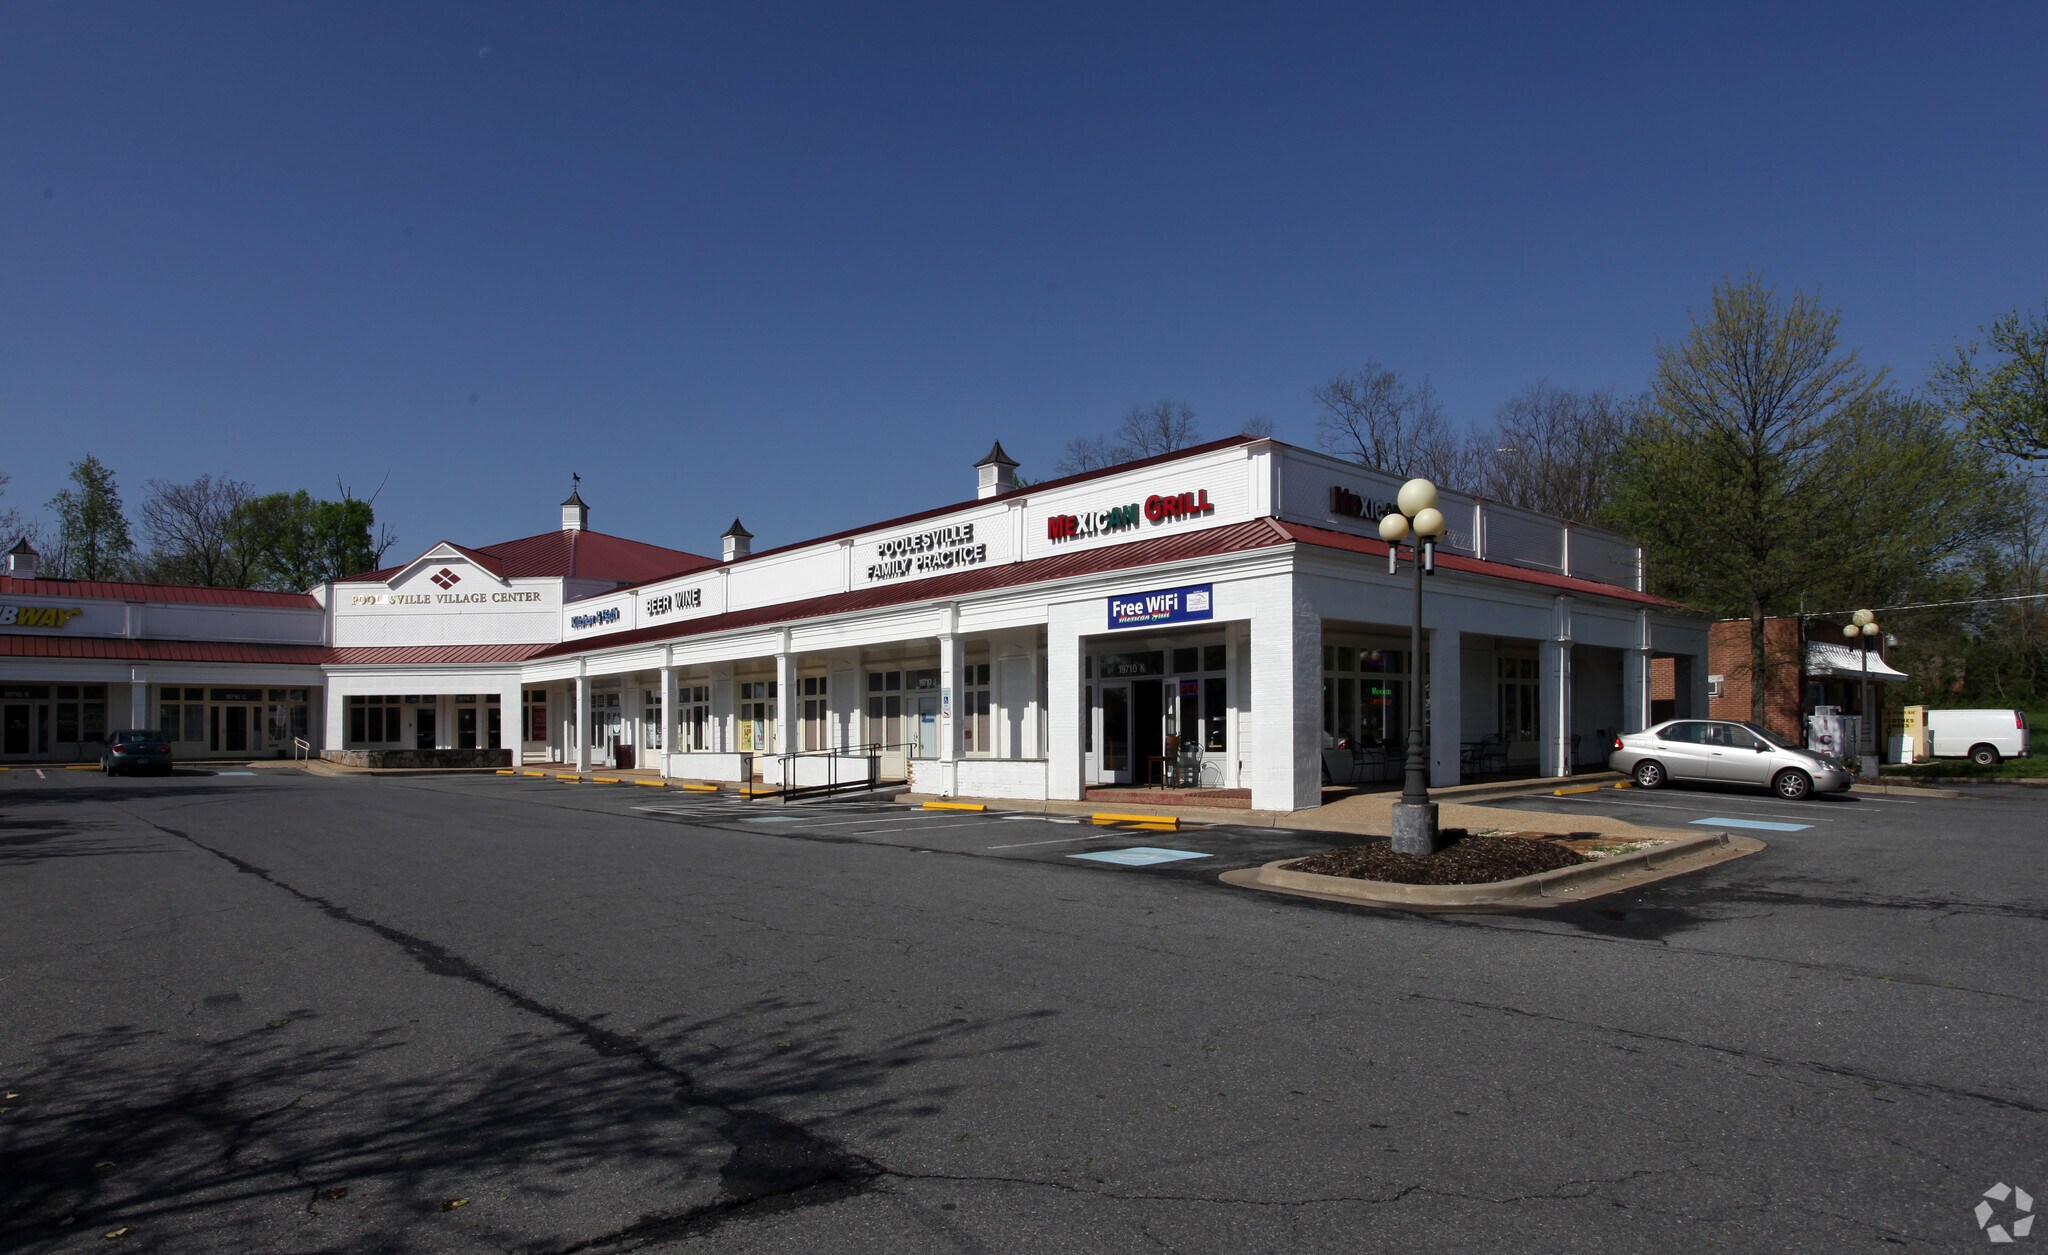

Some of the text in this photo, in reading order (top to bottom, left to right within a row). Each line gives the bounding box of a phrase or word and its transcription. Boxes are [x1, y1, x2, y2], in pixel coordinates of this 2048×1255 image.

[1048, 489, 1212, 539] MEXICAN GRILL
[1330, 486, 1402, 521] MEXICA
[878, 523, 974, 556] POOLESVILLE
[866, 543, 986, 578] FAMILY PRACTICE
[436, 593, 487, 605] VILLAGE
[491, 591, 541, 604] CENTER
[647, 588, 700, 612] BEER WINE
[1113, 600, 1144, 617] Free
[1146, 593, 1178, 613] WiFi
[0, 606, 82, 627] BWAY
[1120, 663, 1145, 673] 19710 K
